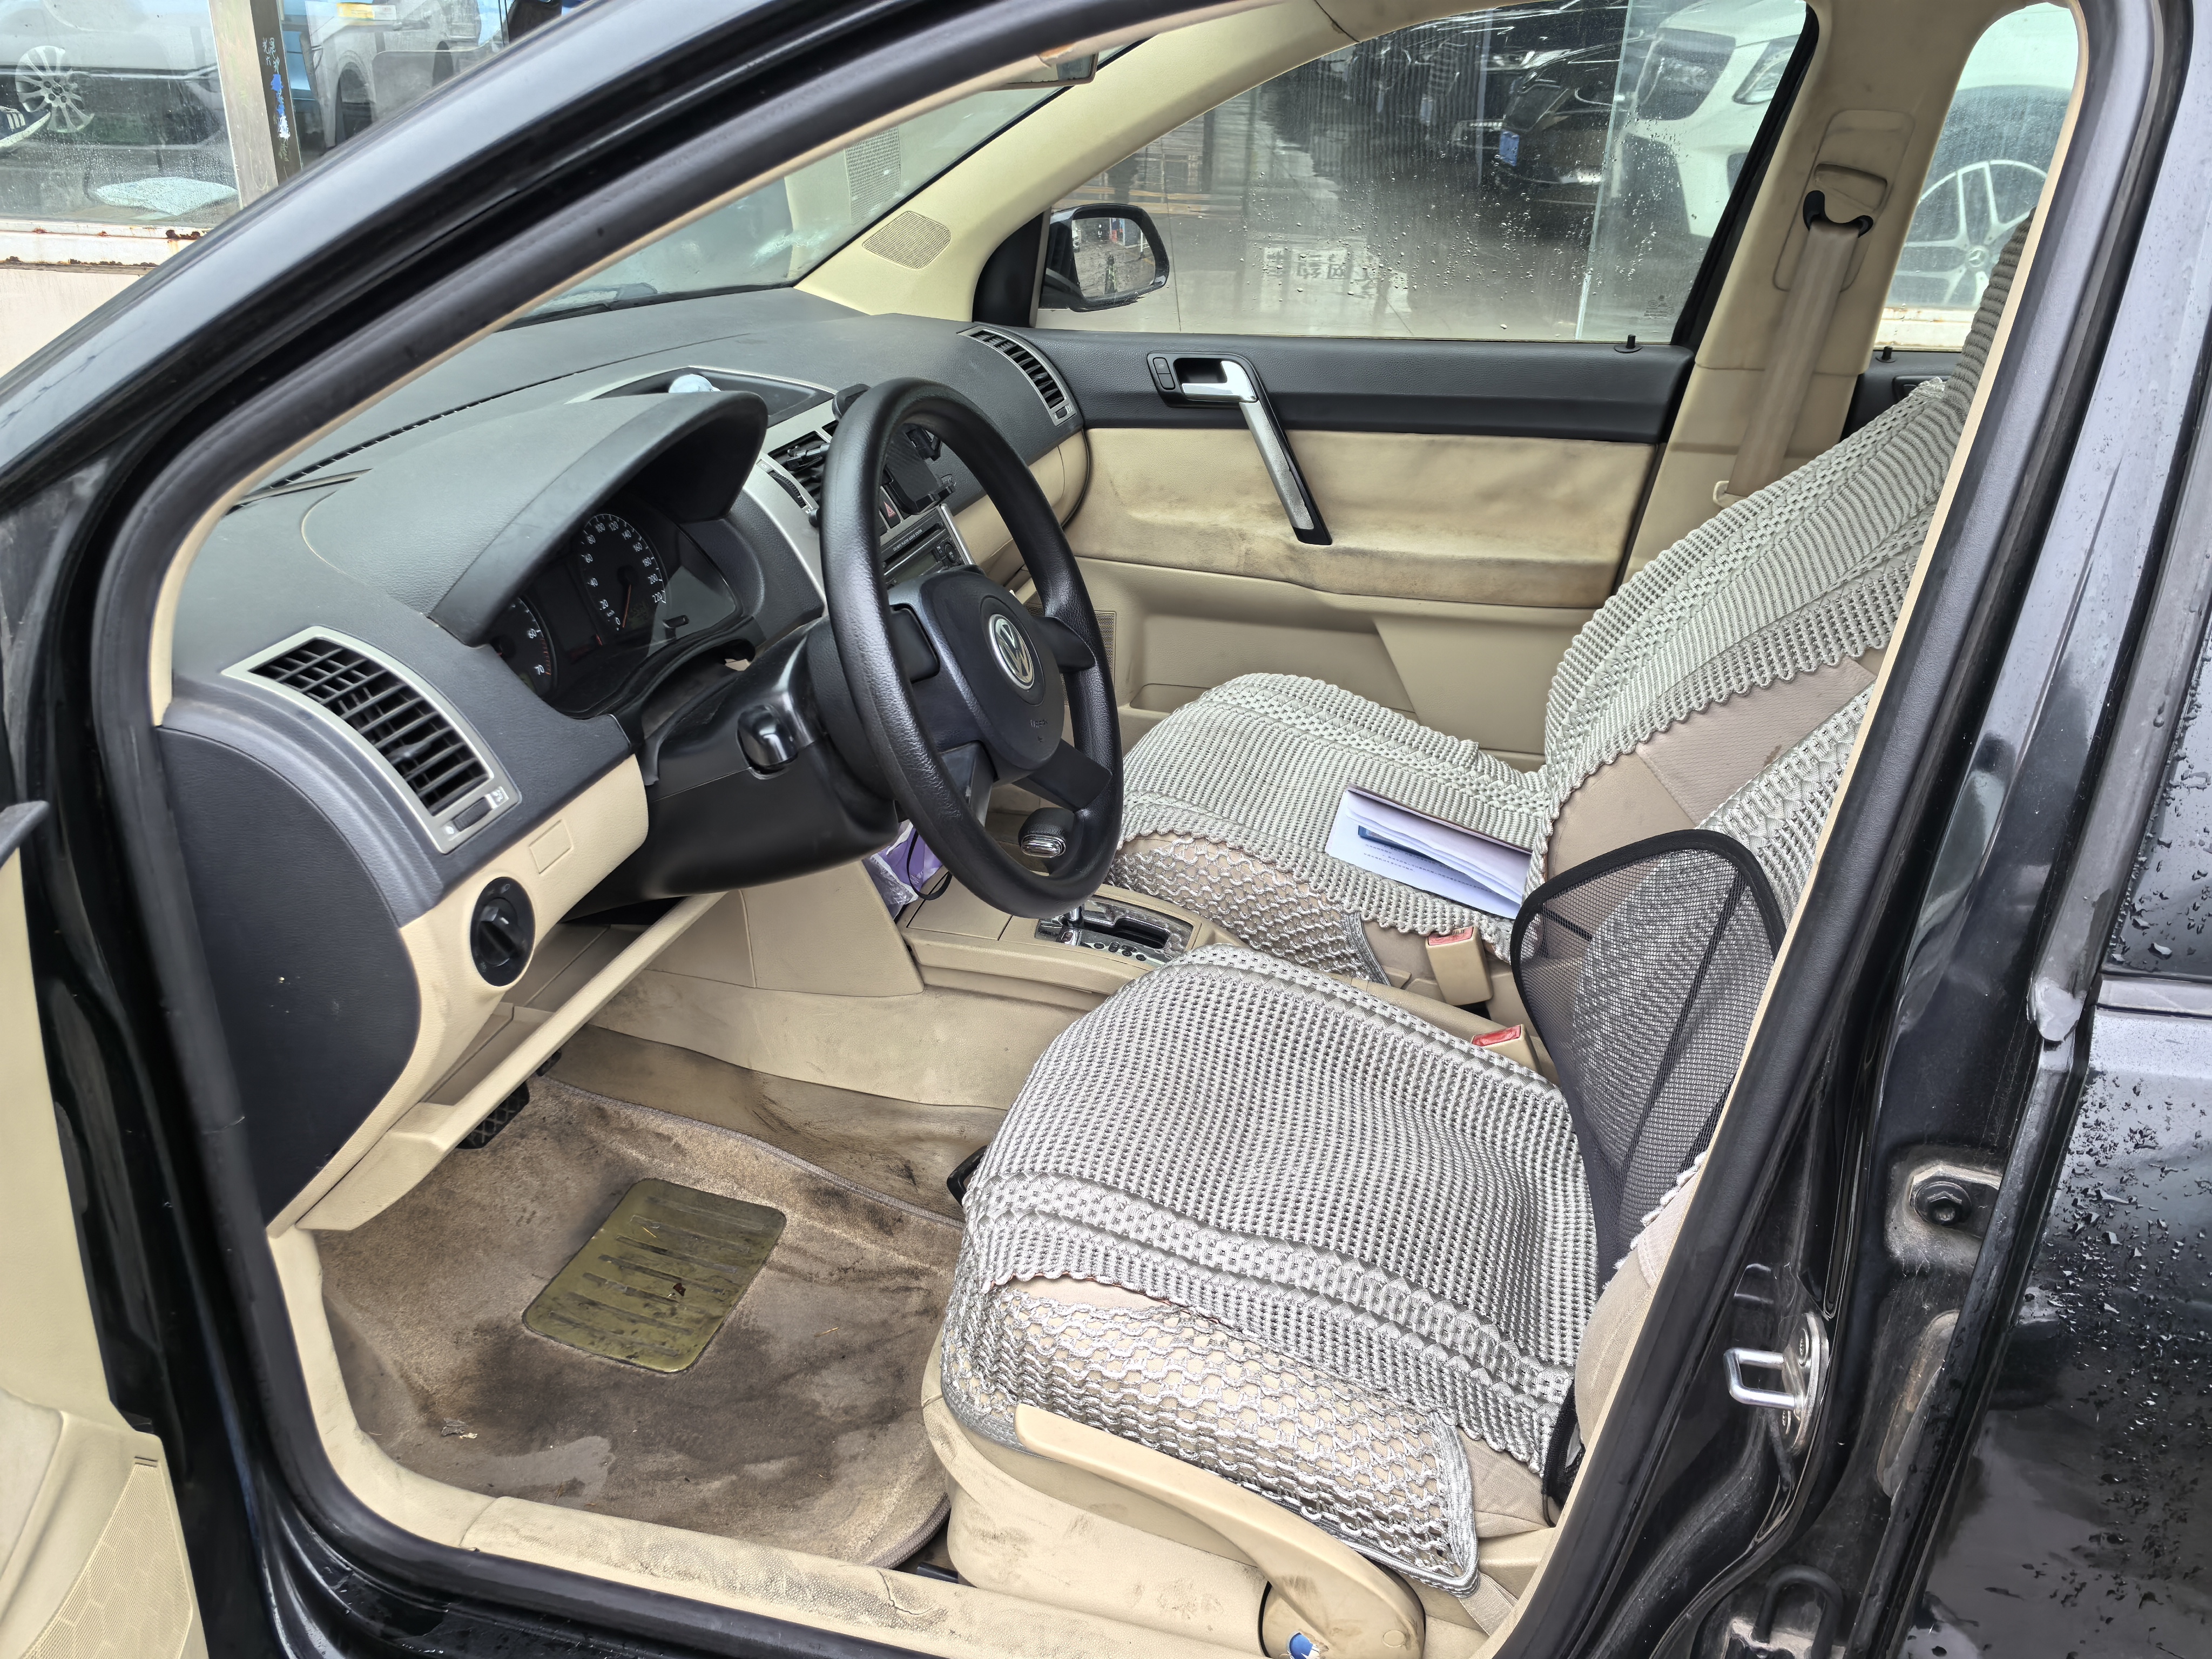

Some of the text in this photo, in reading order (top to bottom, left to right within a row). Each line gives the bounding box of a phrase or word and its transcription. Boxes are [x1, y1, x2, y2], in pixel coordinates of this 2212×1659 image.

[595, 522, 605, 533] 100
[609, 521, 619, 531] 120
[586, 535, 596, 544] 80
[621, 529, 632, 541] 140
[632, 542, 643, 552] 160
[585, 554, 594, 563] 60
[642, 557, 652, 567] 180
[648, 574, 658, 584] 200
[652, 592, 662, 603] 220
[599, 599, 609, 609] 20
[615, 617, 621, 625] 0
[528, 628, 537, 639] 60
[534, 664, 545, 675] 70
